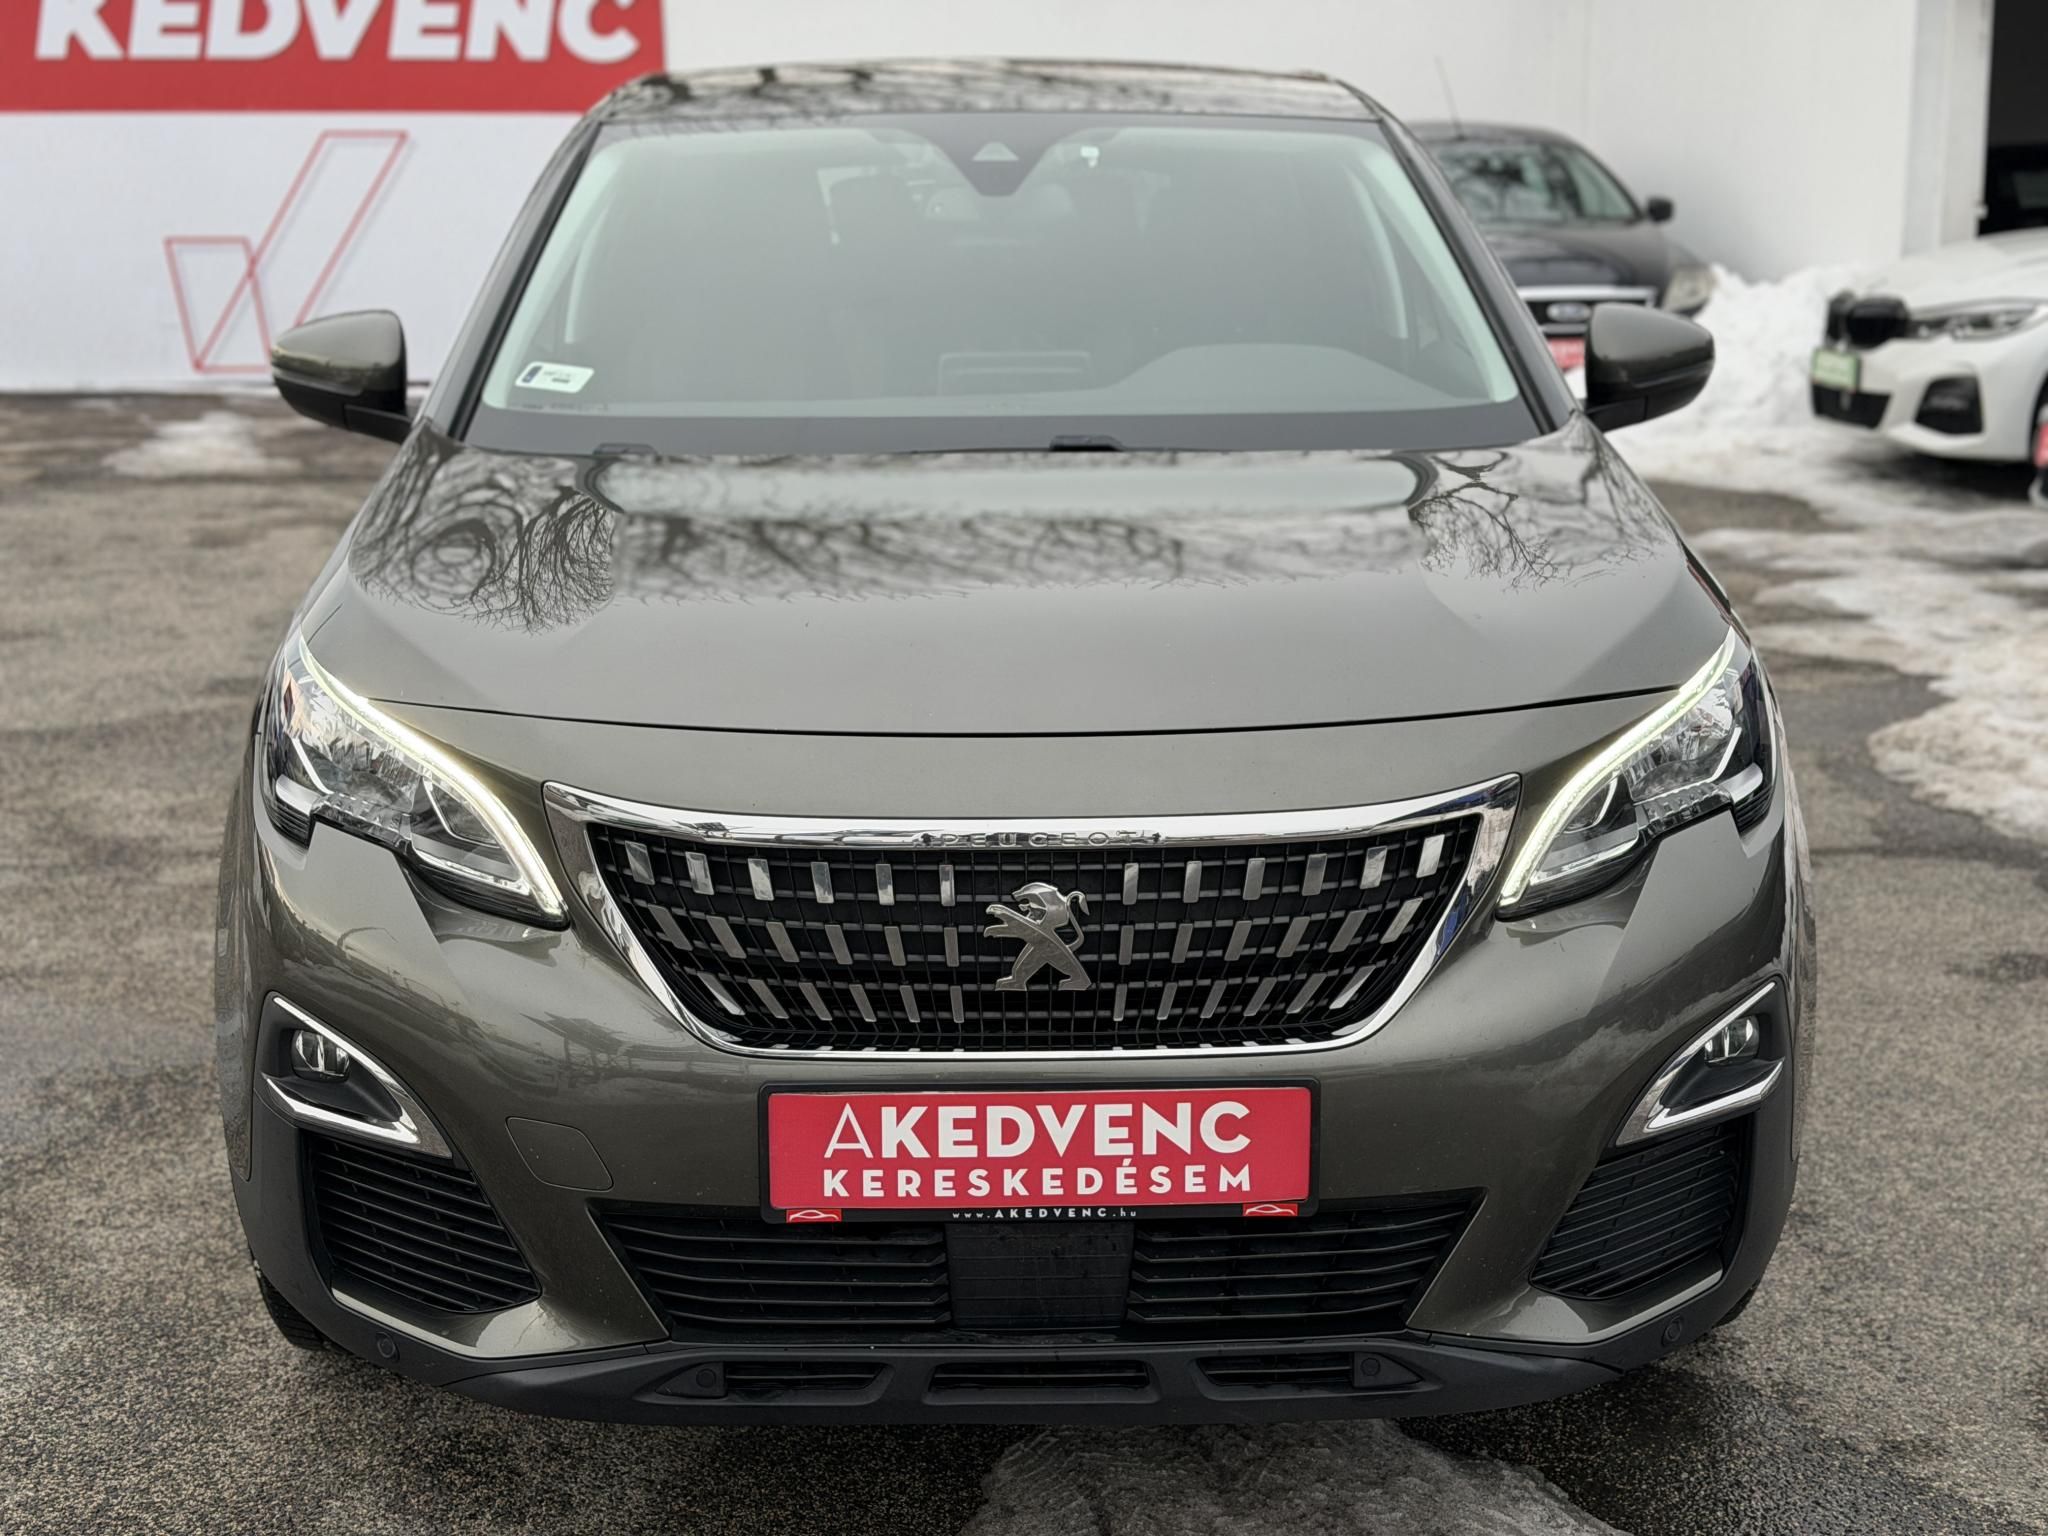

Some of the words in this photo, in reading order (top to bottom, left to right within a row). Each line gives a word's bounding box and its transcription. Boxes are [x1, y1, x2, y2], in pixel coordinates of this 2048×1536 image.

[35, 0, 640, 63] KEDVENC
[940, 830, 1137, 847] PEUGEOT
[823, 1159, 1251, 1198] KERESKEDÉSEM
[952, 1207, 1137, 1219] www.AKEDVENC.hu
